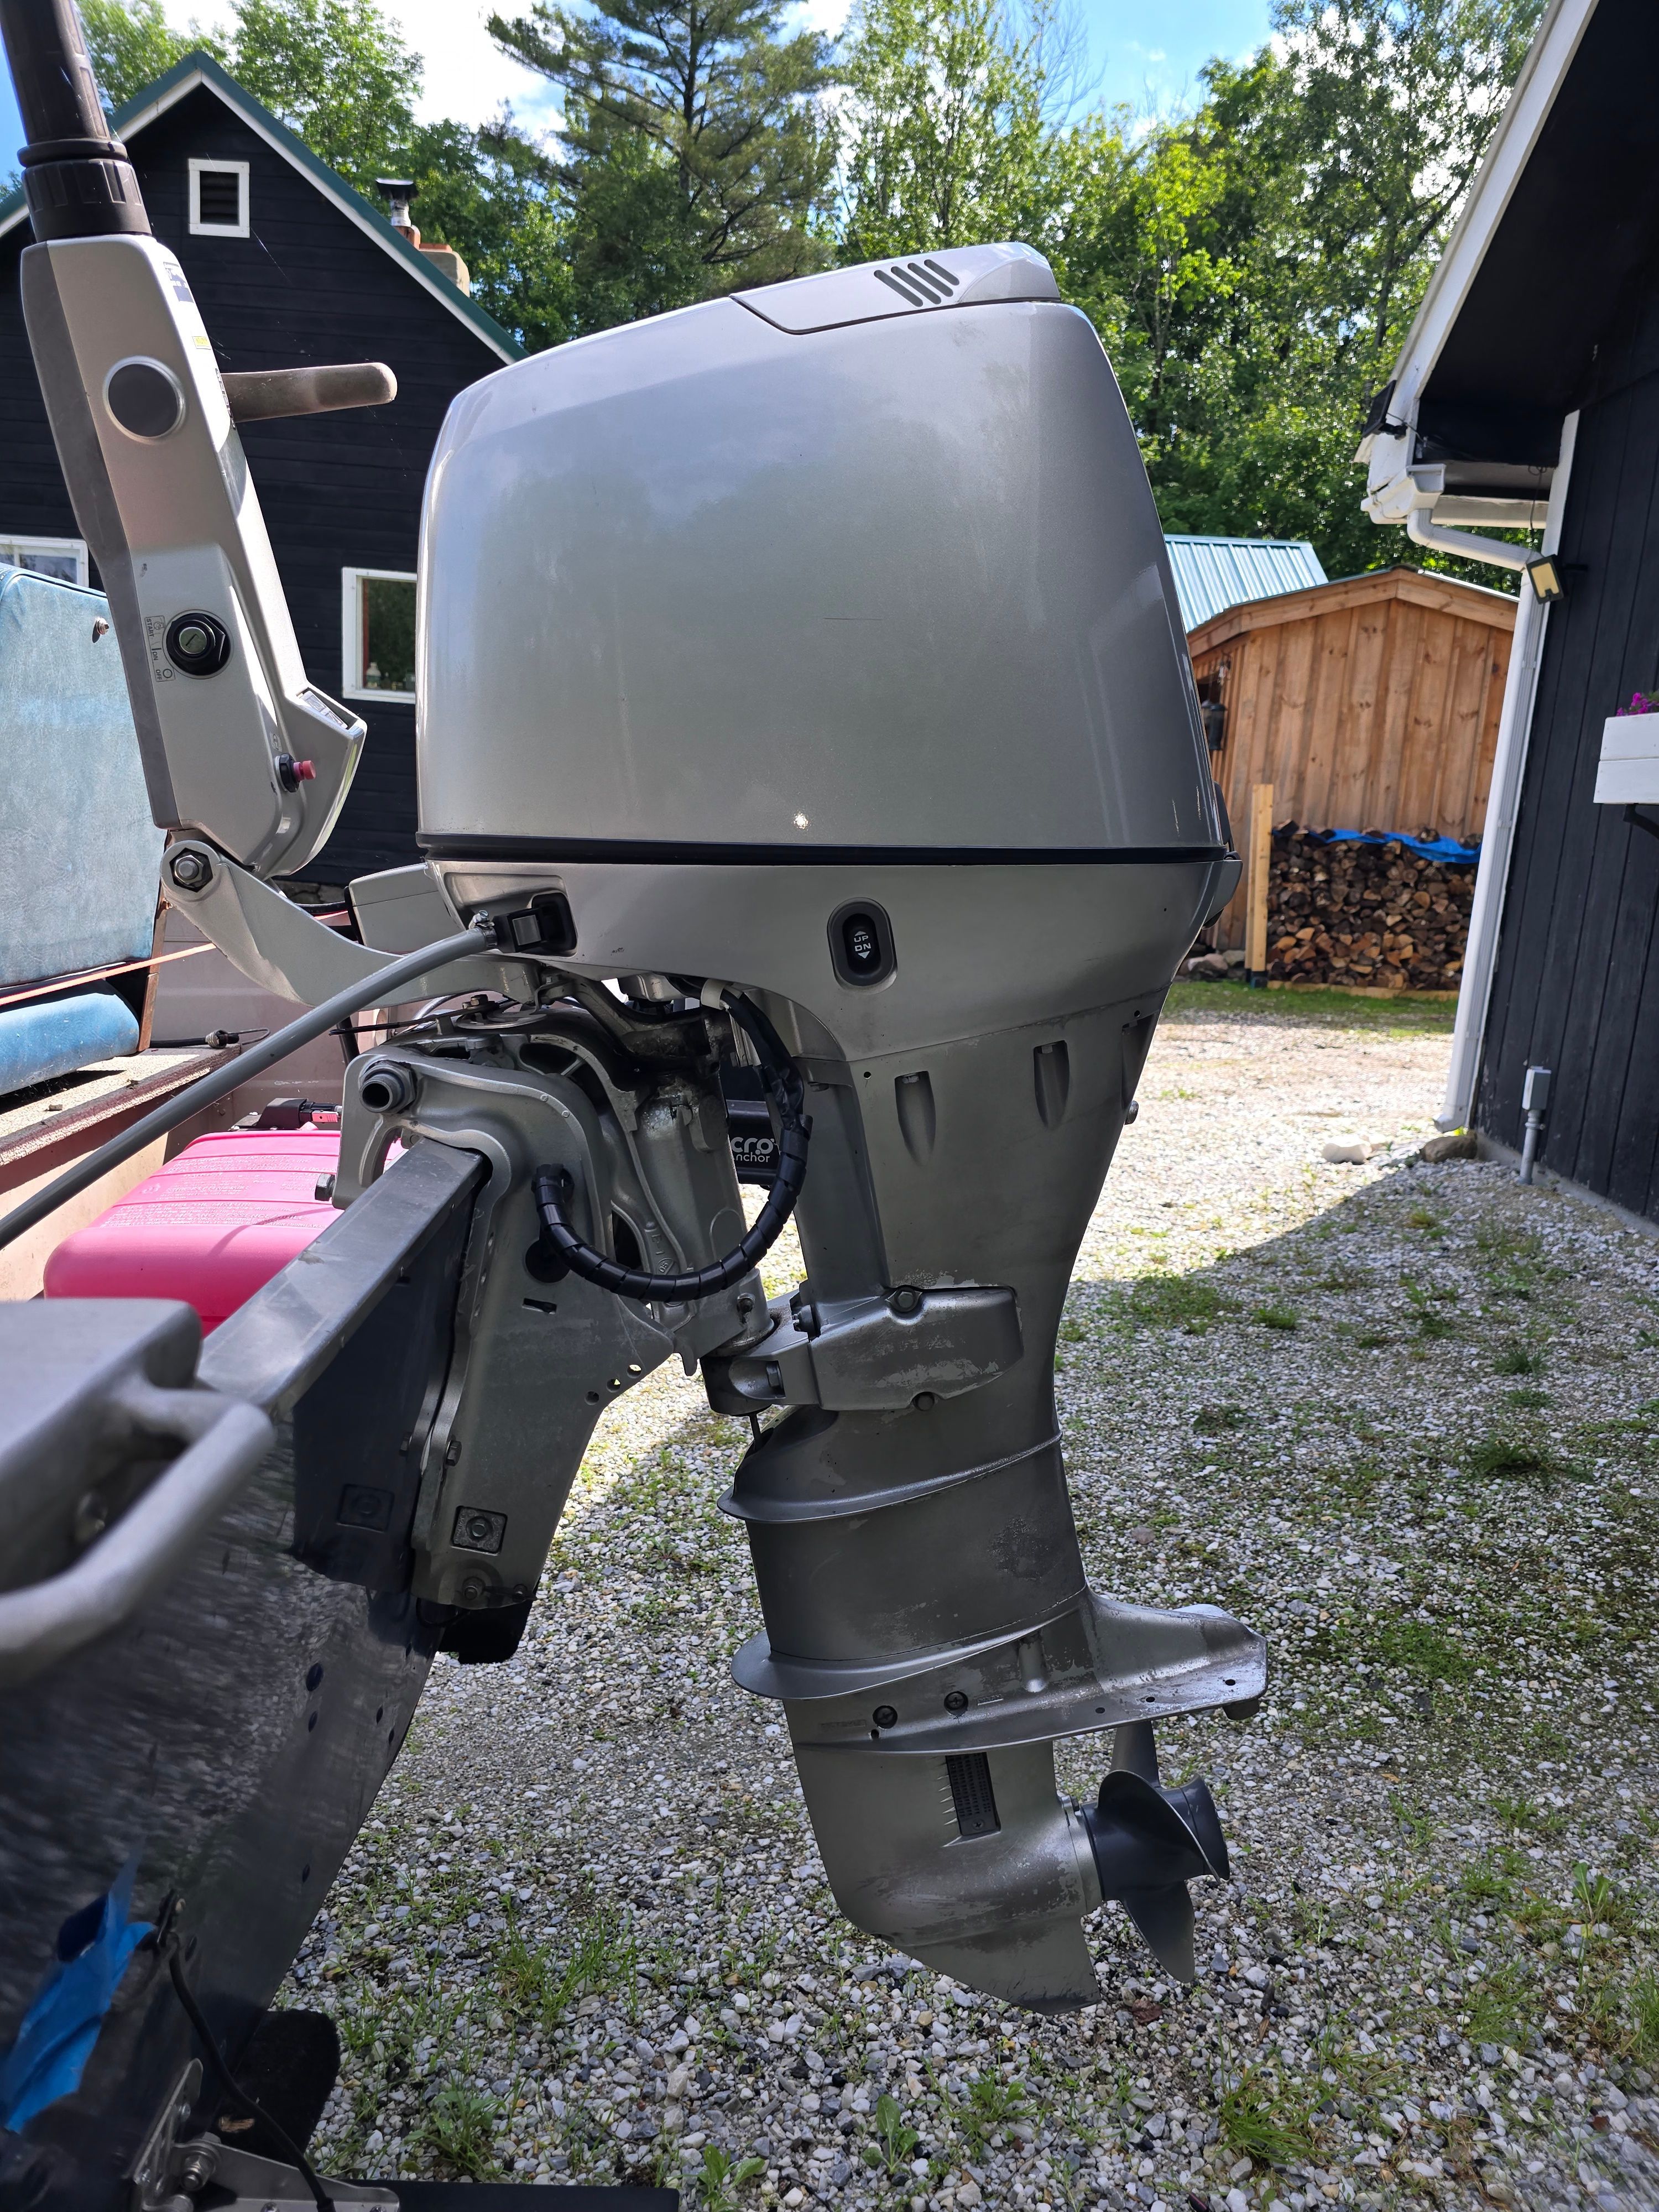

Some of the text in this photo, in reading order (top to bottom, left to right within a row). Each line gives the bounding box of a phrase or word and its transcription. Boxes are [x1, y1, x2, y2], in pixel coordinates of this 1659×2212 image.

[152, 652, 159, 661] ON
[854, 943, 872, 952] DN
[731, 1136, 774, 1155] cro
[734, 1151, 770, 1163] nchor
